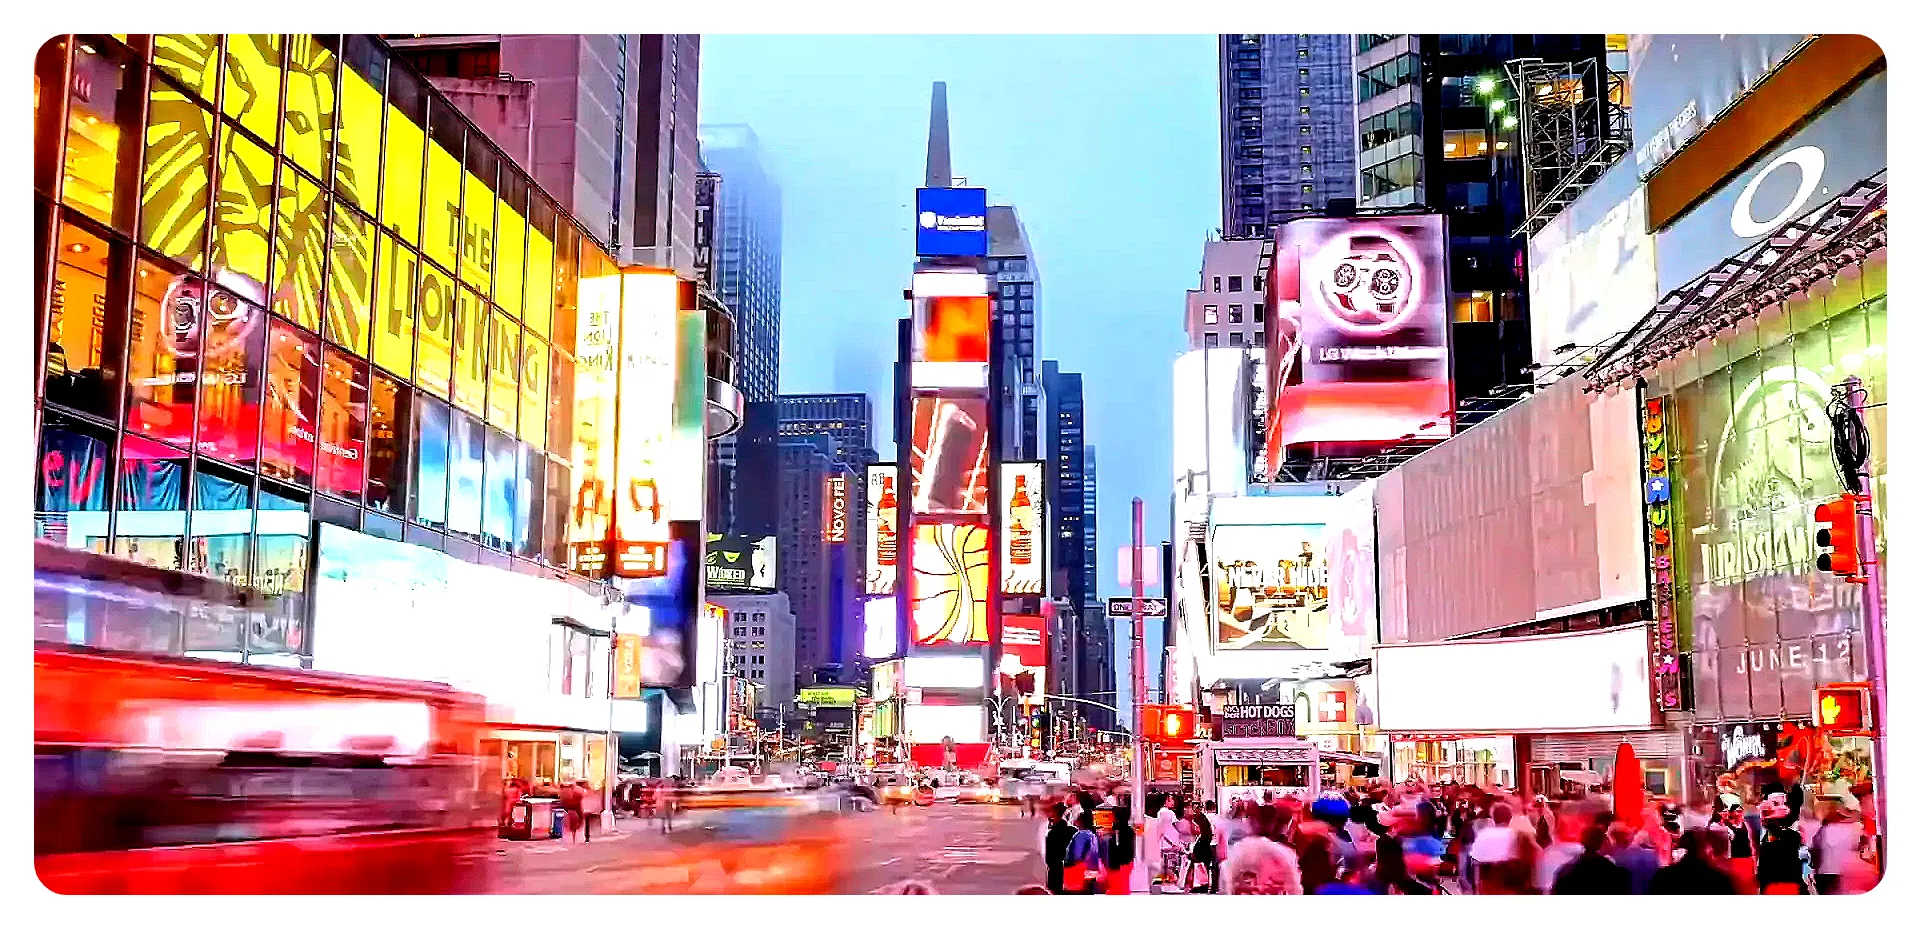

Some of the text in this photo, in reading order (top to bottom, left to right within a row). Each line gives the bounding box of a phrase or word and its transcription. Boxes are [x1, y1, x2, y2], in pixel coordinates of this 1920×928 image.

[447, 200, 490, 273] THE
[388, 223, 538, 394] LION KING
[832, 471, 847, 542] NOVOTEL
[1736, 634, 1852, 675] JUNE 12
[1240, 705, 1263, 719] HOT
[1263, 705, 1295, 719] DOGS
